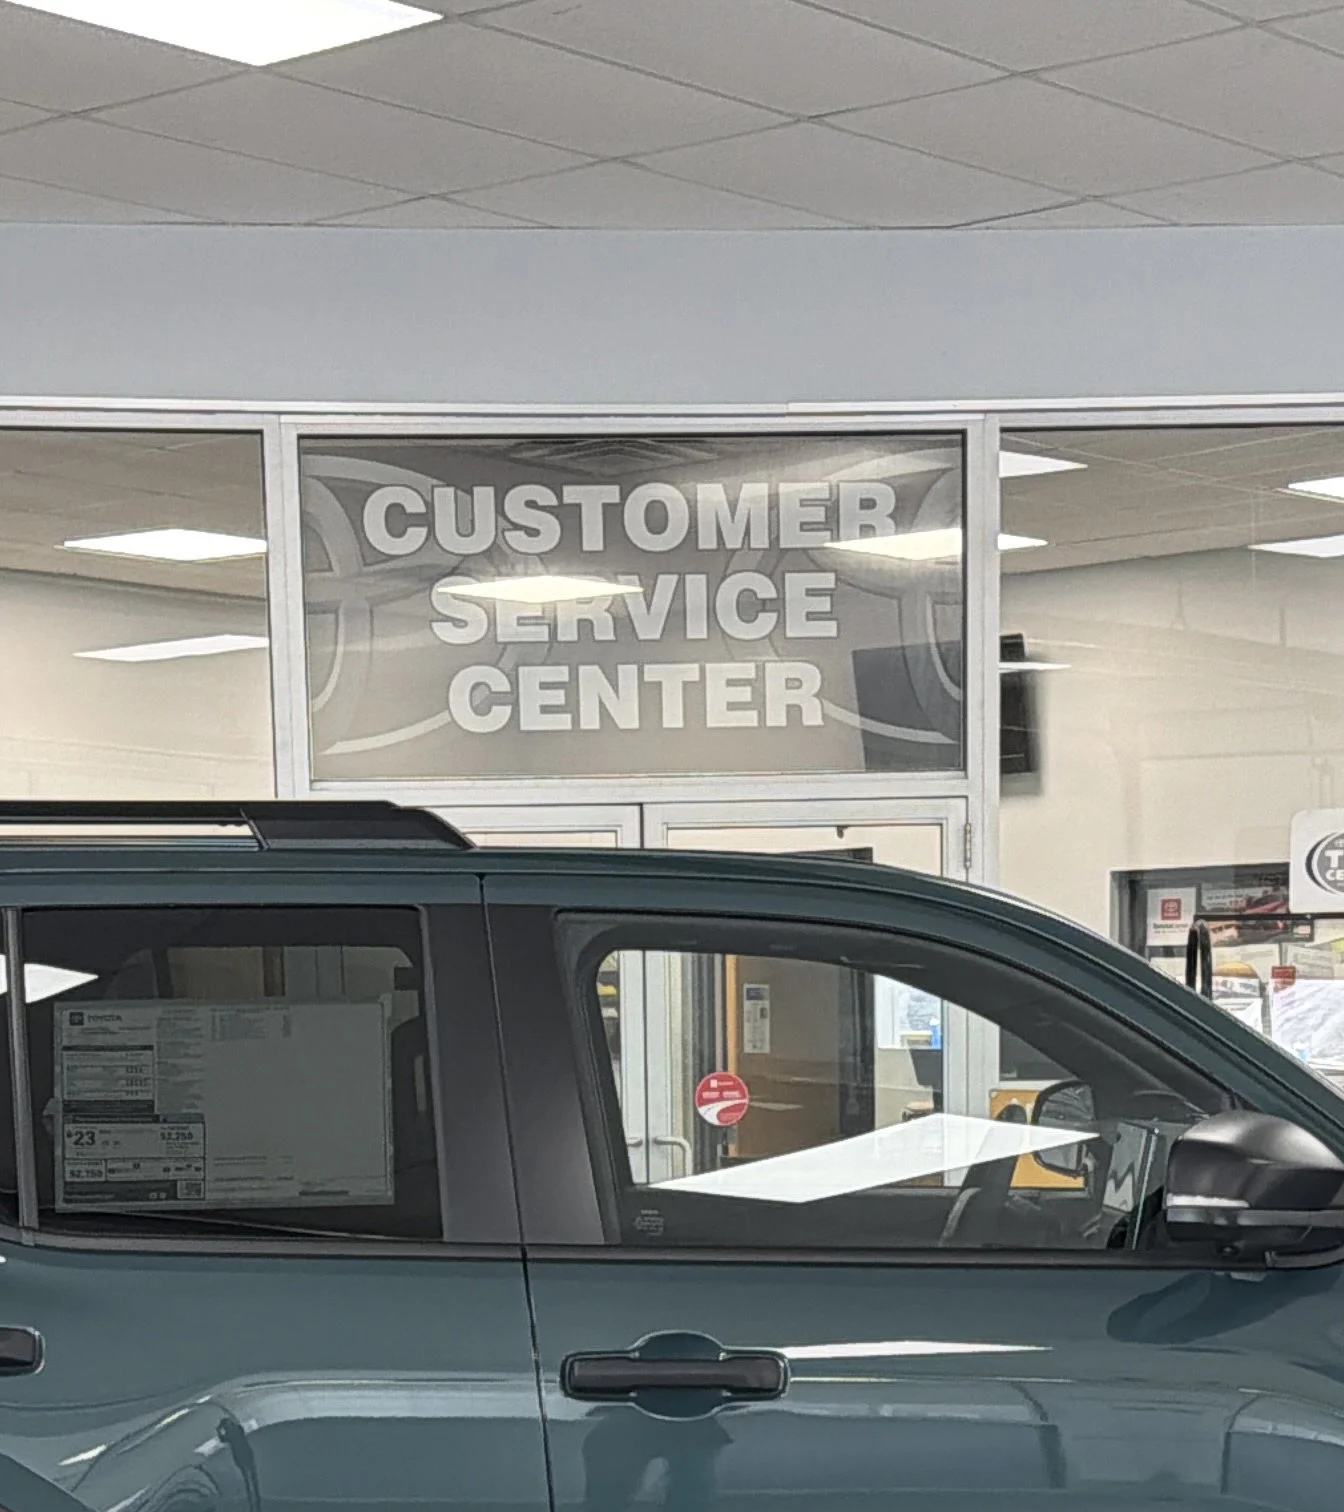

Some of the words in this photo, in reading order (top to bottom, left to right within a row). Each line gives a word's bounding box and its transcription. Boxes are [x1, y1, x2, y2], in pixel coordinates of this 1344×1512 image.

[362, 482, 897, 556] CUSTOMER
[430, 572, 839, 644] SERVICE
[448, 661, 824, 733] CENTER
[72, 1130, 96, 1146] 23
